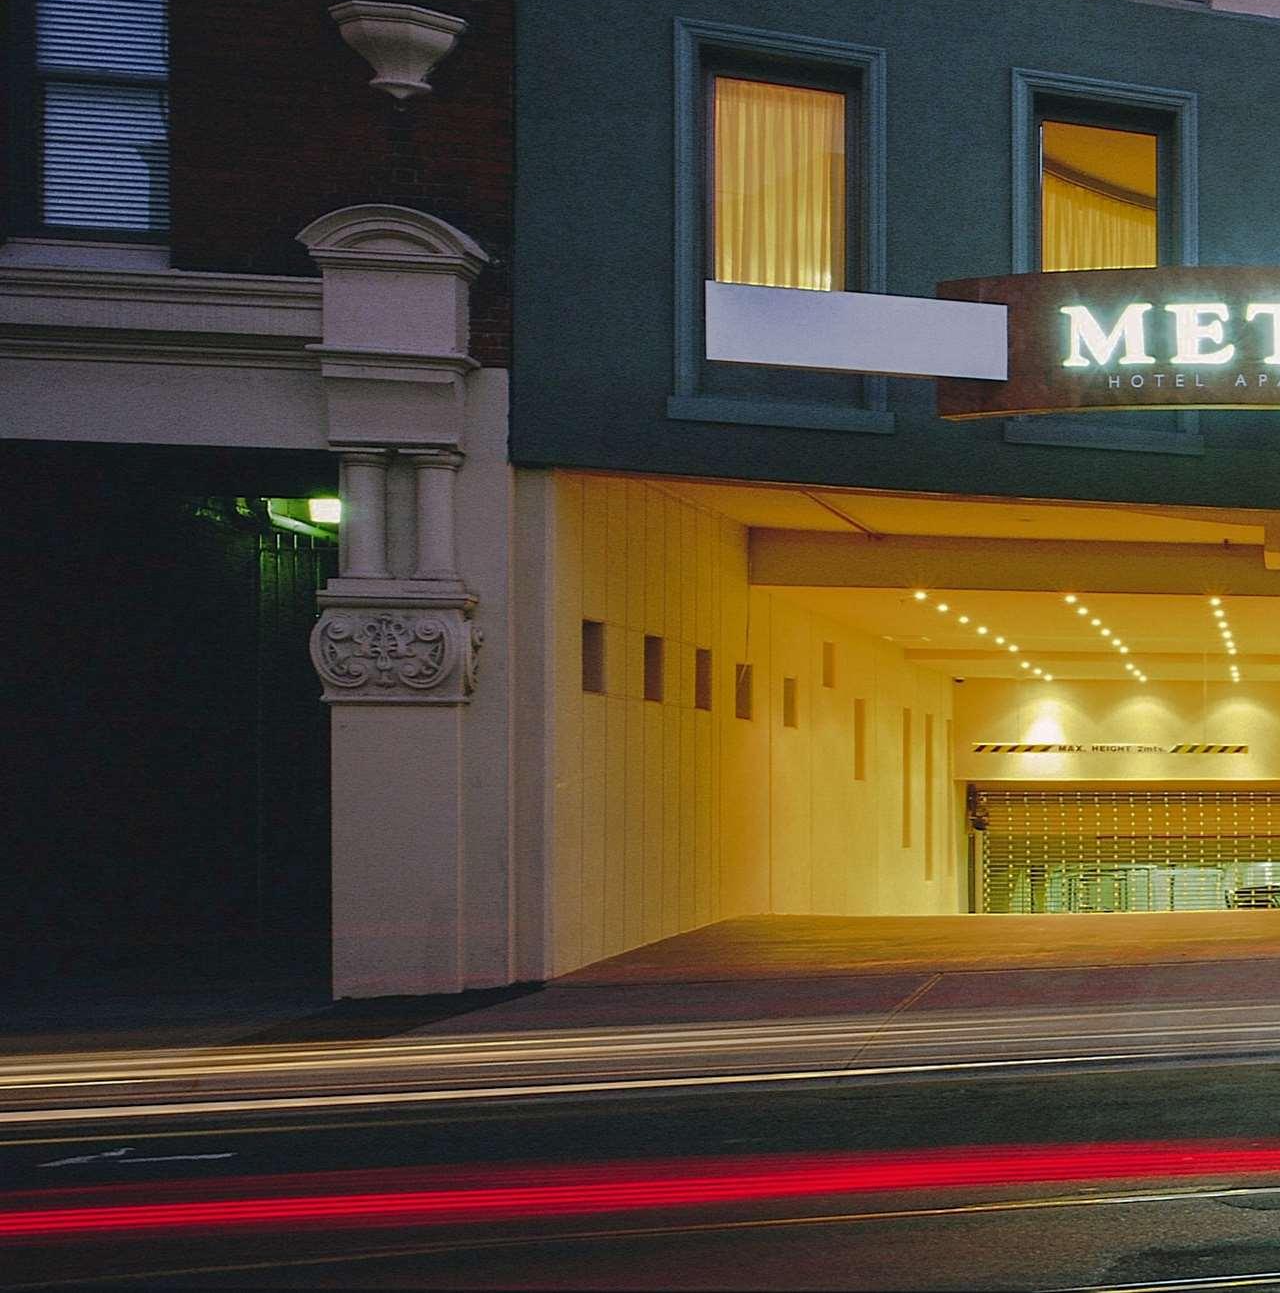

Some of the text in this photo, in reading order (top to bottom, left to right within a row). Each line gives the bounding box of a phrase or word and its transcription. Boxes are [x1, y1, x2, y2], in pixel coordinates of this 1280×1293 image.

[1109, 373, 1204, 388] HOTEL
[1057, 744, 1087, 753] MAX.
[1091, 744, 1132, 753] HEIGHT
